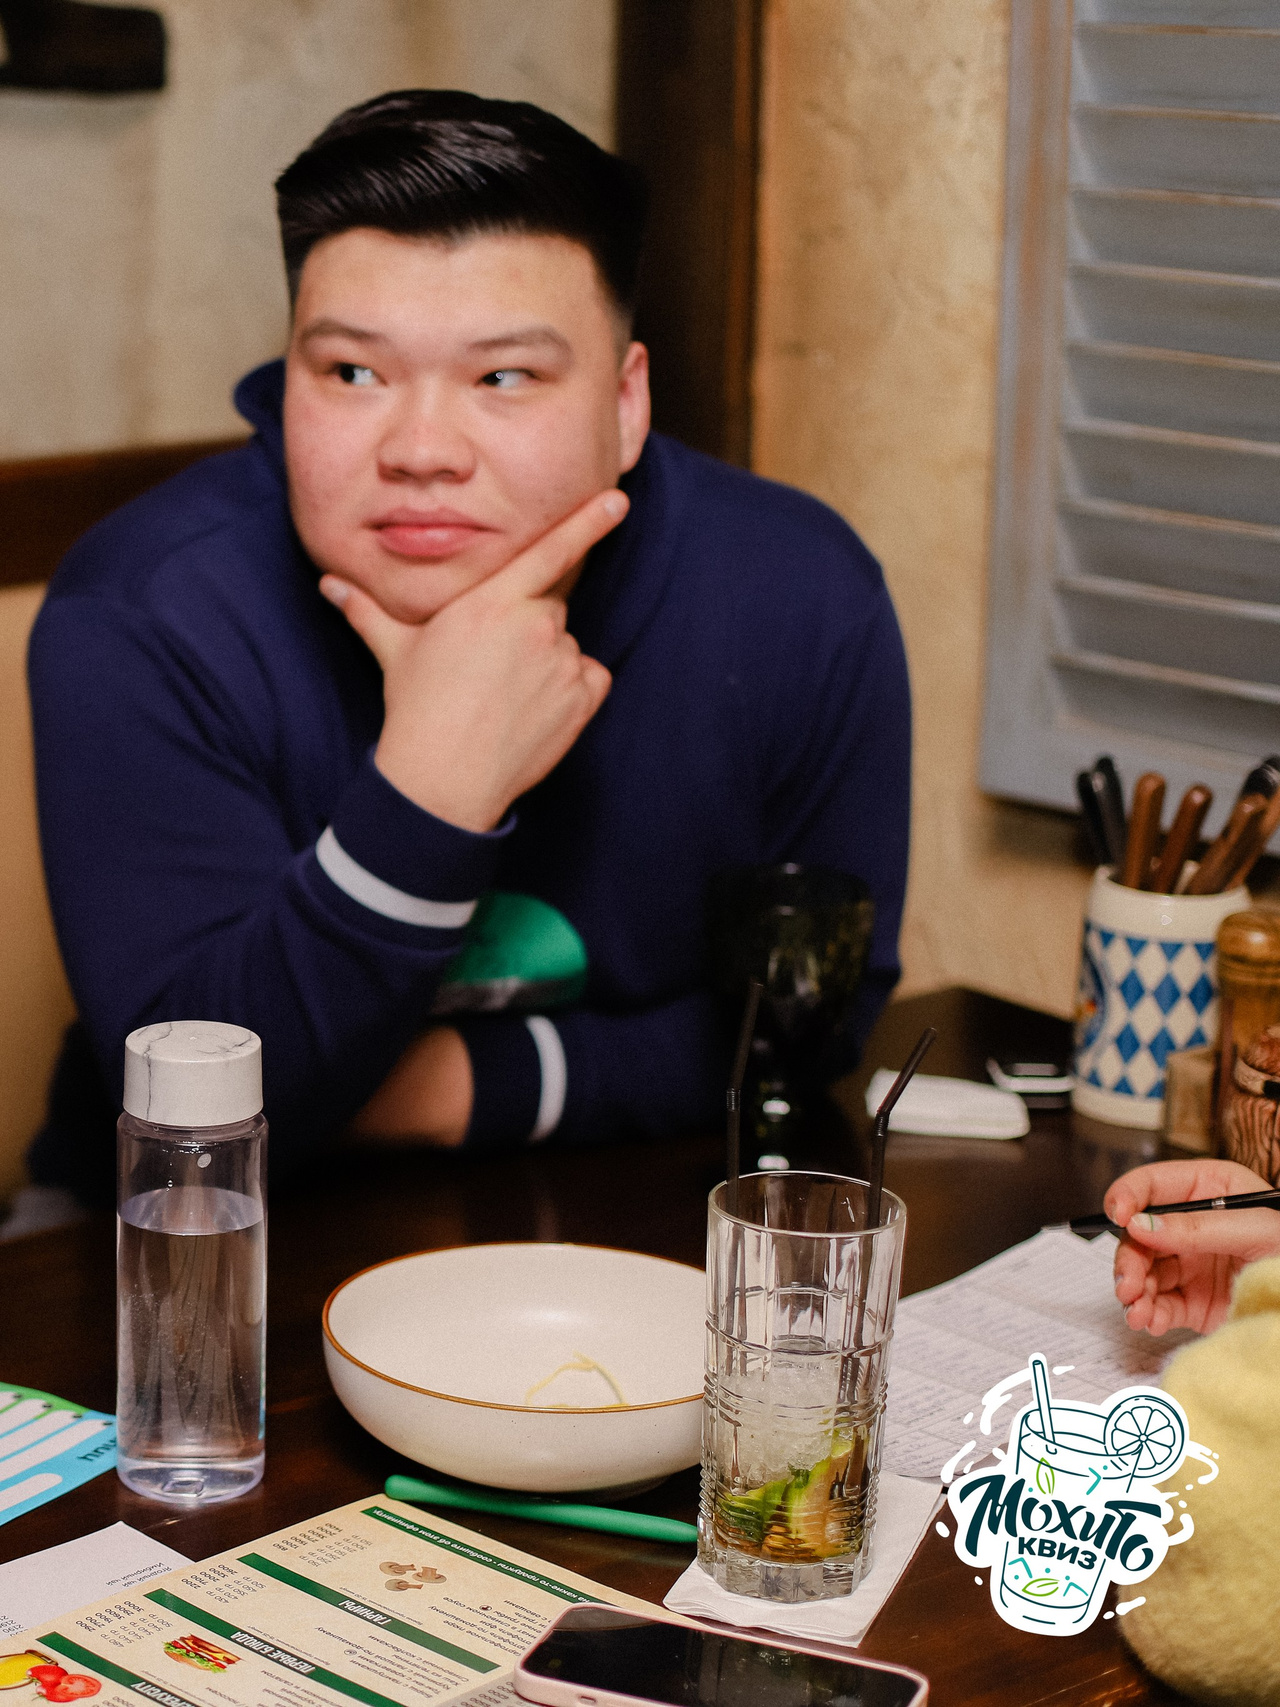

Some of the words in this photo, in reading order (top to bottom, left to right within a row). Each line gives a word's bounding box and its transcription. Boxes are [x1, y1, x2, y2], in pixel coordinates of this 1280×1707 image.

[339, 1600, 391, 1624] ГАРНИРЫ
[231, 1632, 274, 1653] БЛЮДА
[268, 1650, 315, 1673] ПЕРВЫЕ
